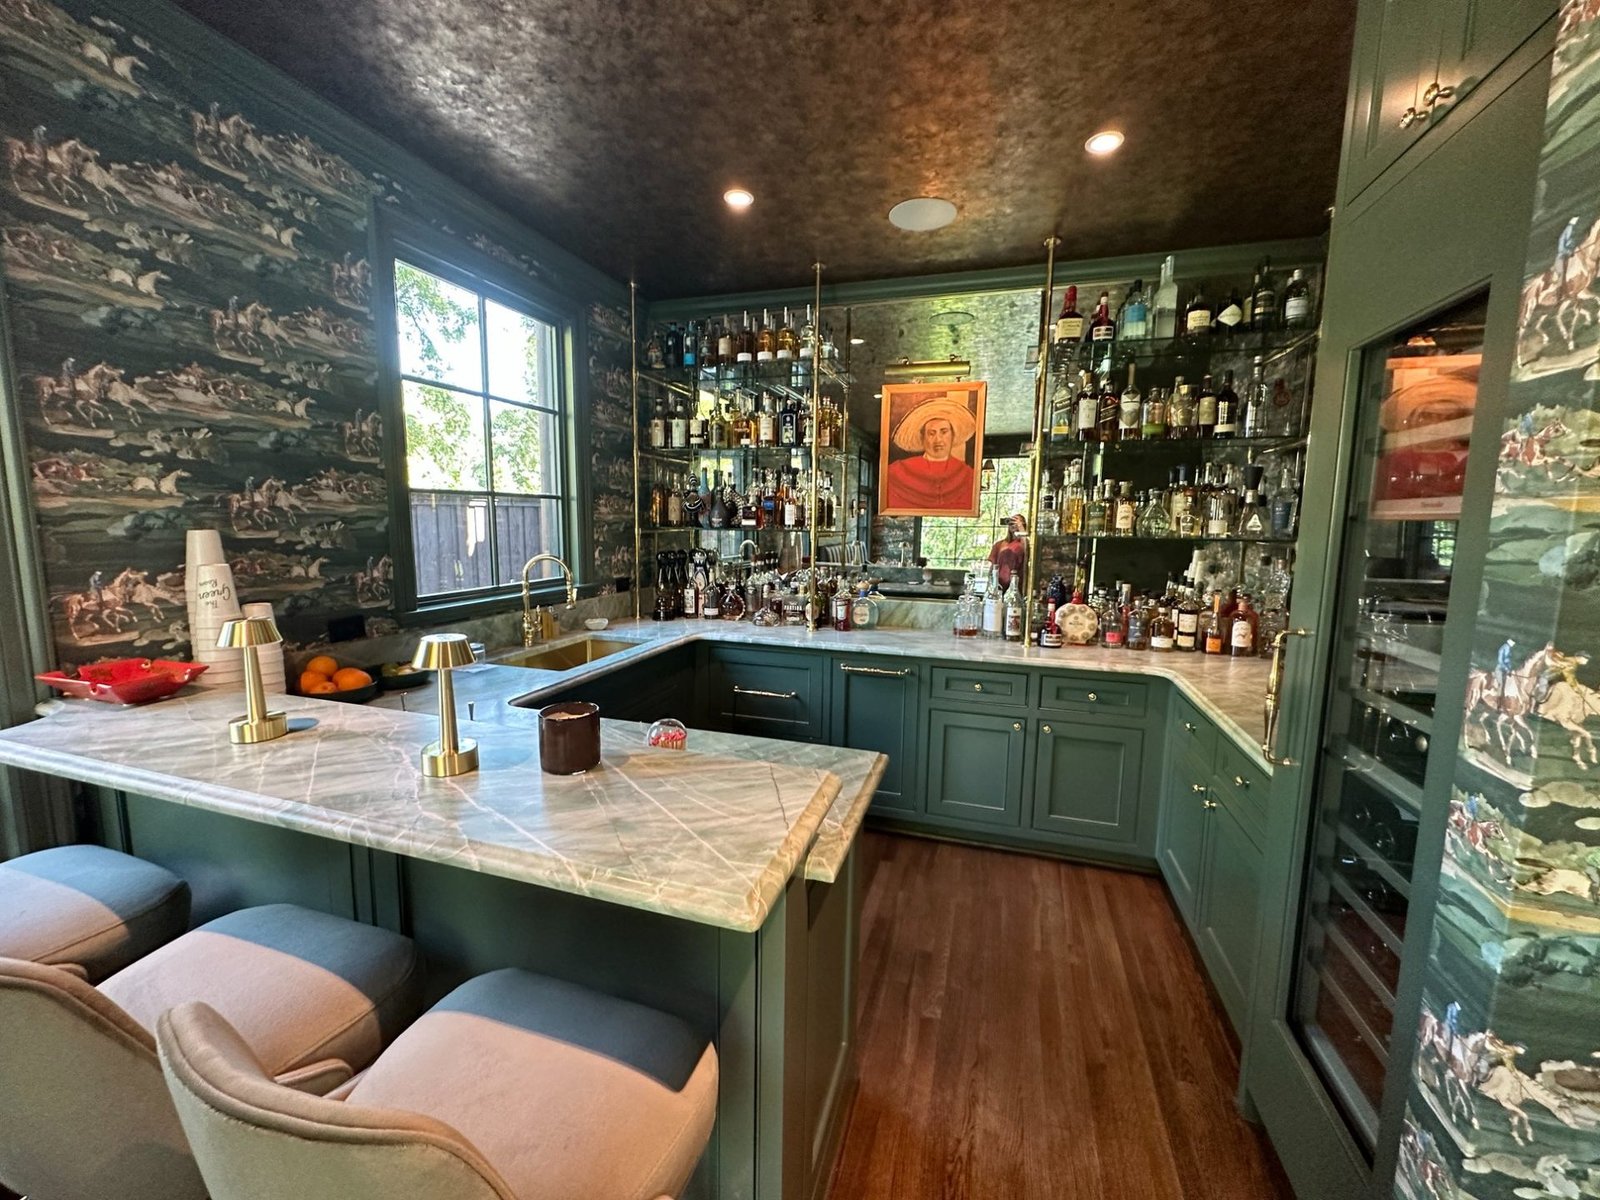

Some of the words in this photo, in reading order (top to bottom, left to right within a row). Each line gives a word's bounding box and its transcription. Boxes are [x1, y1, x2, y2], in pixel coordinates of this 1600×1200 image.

[199, 578, 218, 588] Room
[198, 583, 231, 601] Green
[205, 600, 218, 608] The
